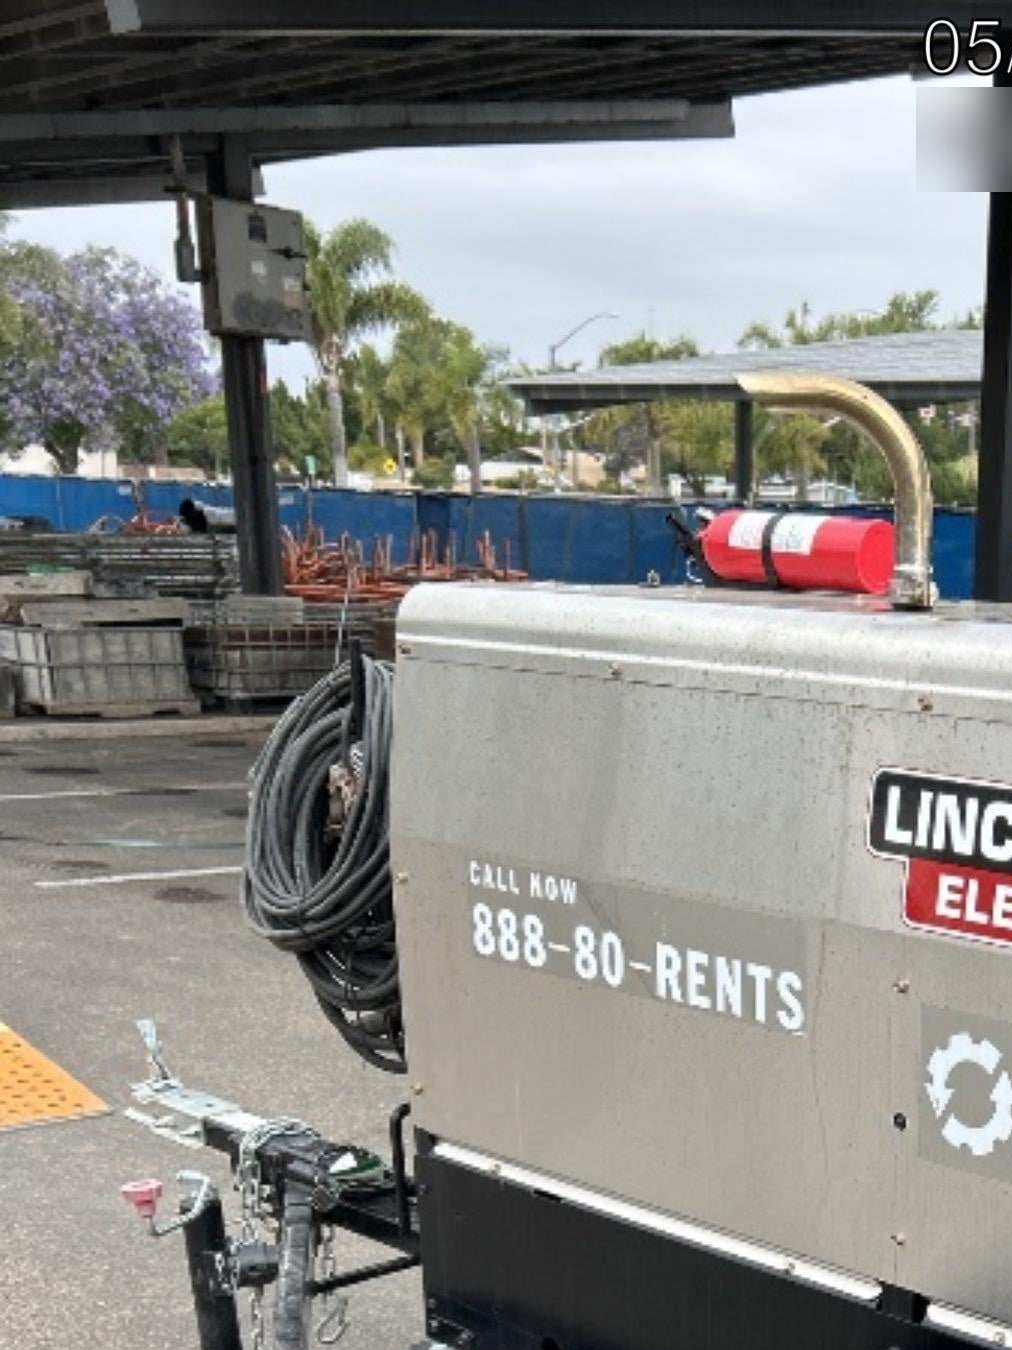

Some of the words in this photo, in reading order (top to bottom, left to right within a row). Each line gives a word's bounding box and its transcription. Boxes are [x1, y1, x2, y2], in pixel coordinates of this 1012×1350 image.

[469, 860, 520, 895] CALL
[529, 871, 578, 905] NOW
[472, 902, 806, 1031] 888-80-RENTS
